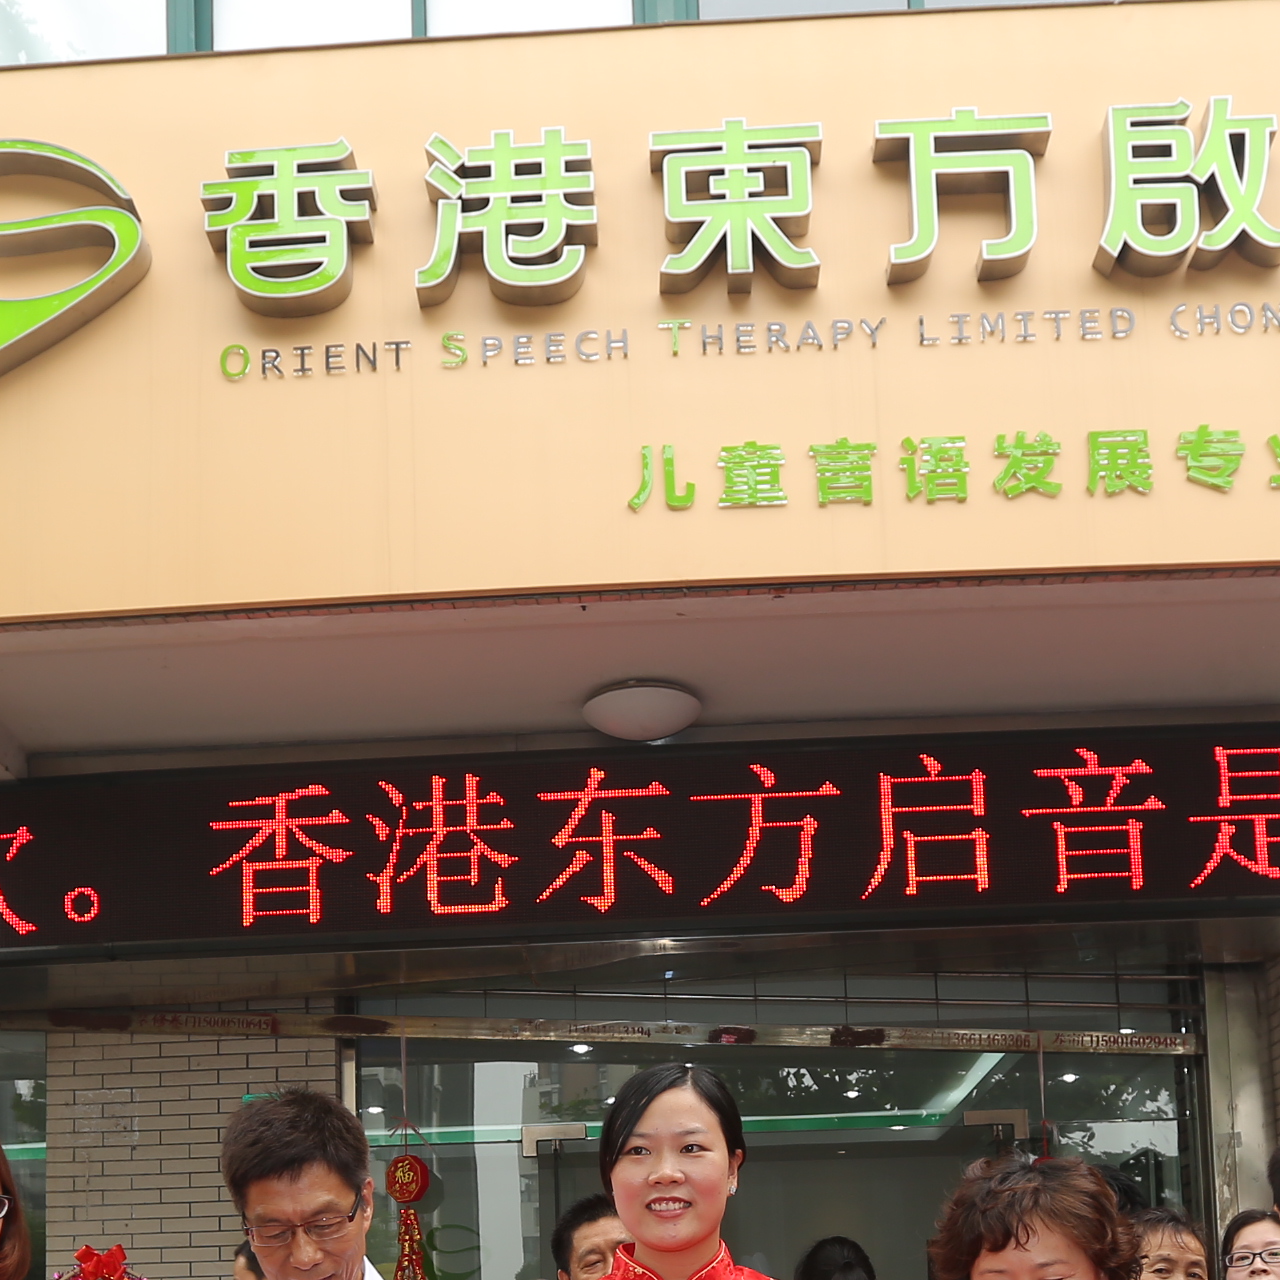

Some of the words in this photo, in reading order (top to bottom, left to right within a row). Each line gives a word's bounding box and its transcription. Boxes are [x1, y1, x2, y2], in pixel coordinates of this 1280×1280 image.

[220, 340, 412, 380] ORIENT
[440, 328, 629, 368] SPEECH
[659, 316, 887, 357] THERAPY
[920, 307, 1136, 347] LIMITED
[395, 1160, 415, 1184] 福
